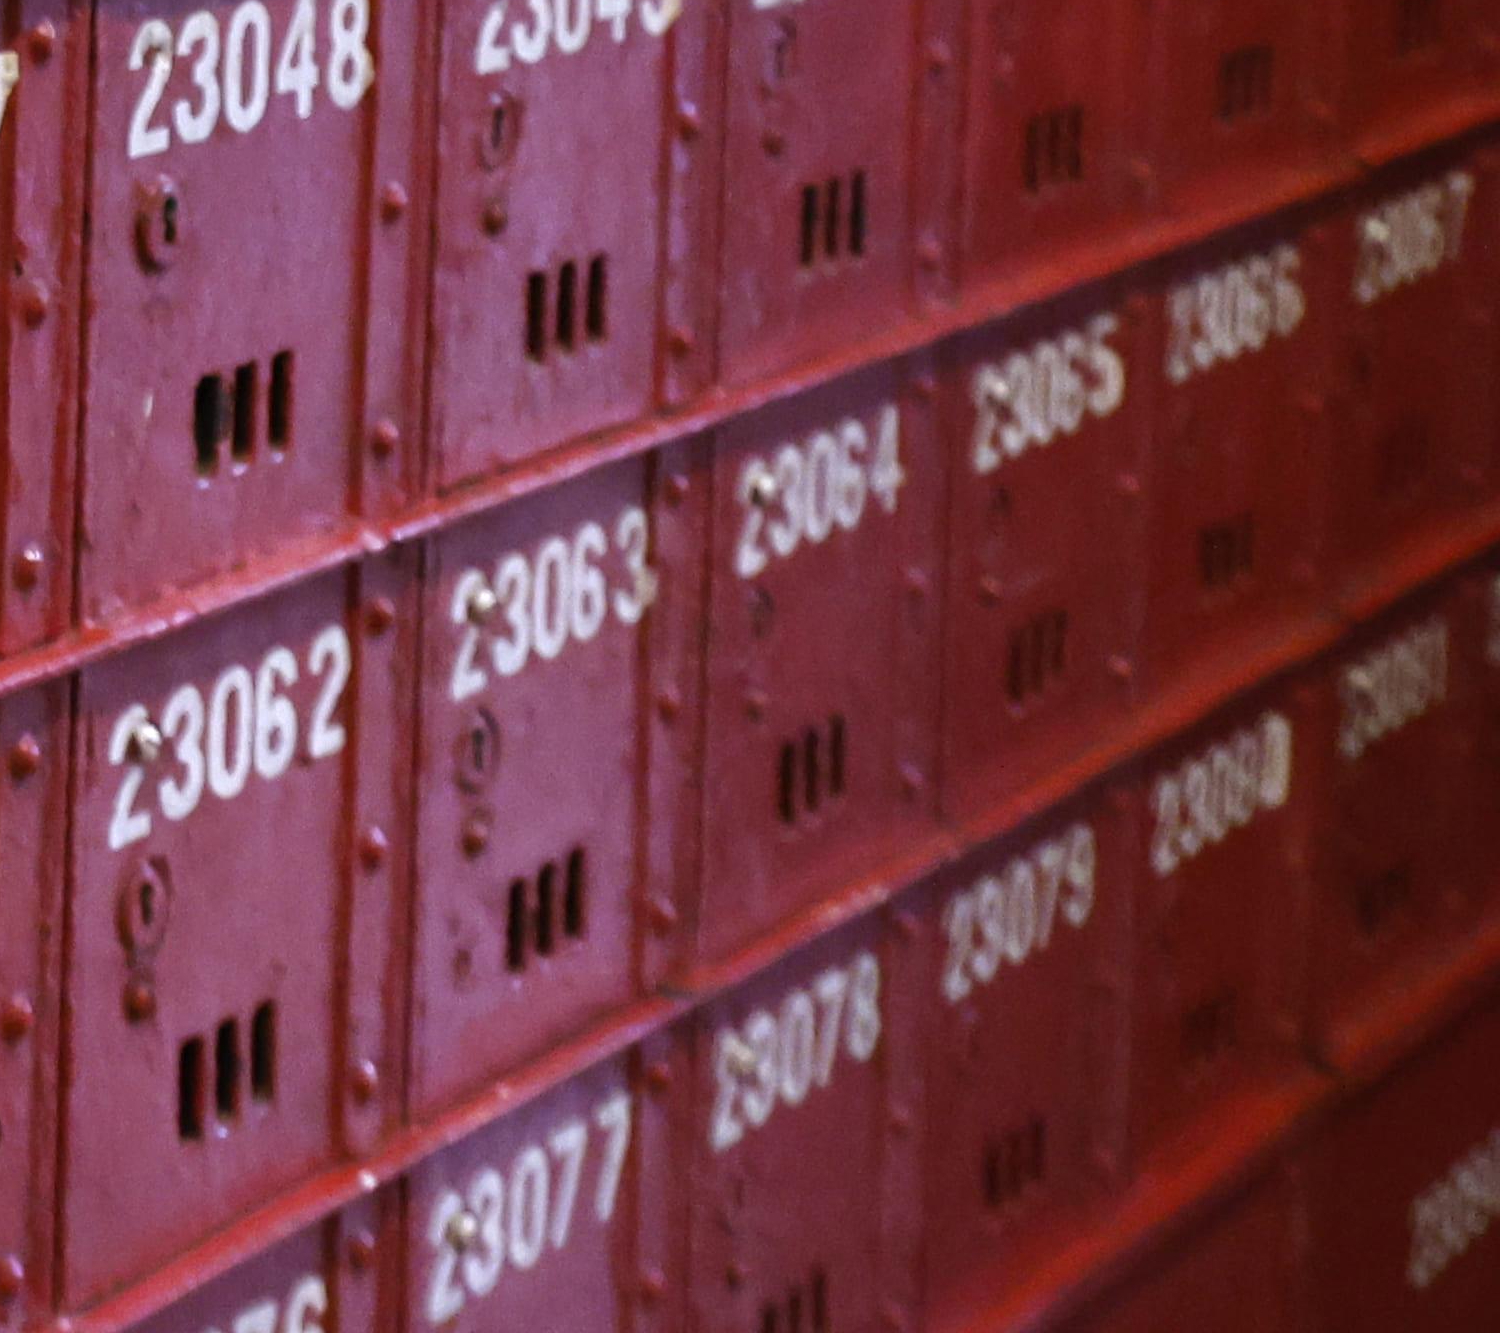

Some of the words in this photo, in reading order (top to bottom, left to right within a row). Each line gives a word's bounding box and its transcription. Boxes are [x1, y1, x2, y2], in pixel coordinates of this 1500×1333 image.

[737, 408, 903, 577] 23064
[450, 509, 653, 701] 23063
[108, 627, 348, 850] 23062
[712, 955, 879, 1149] 23078
[427, 1096, 628, 1322] 23077
